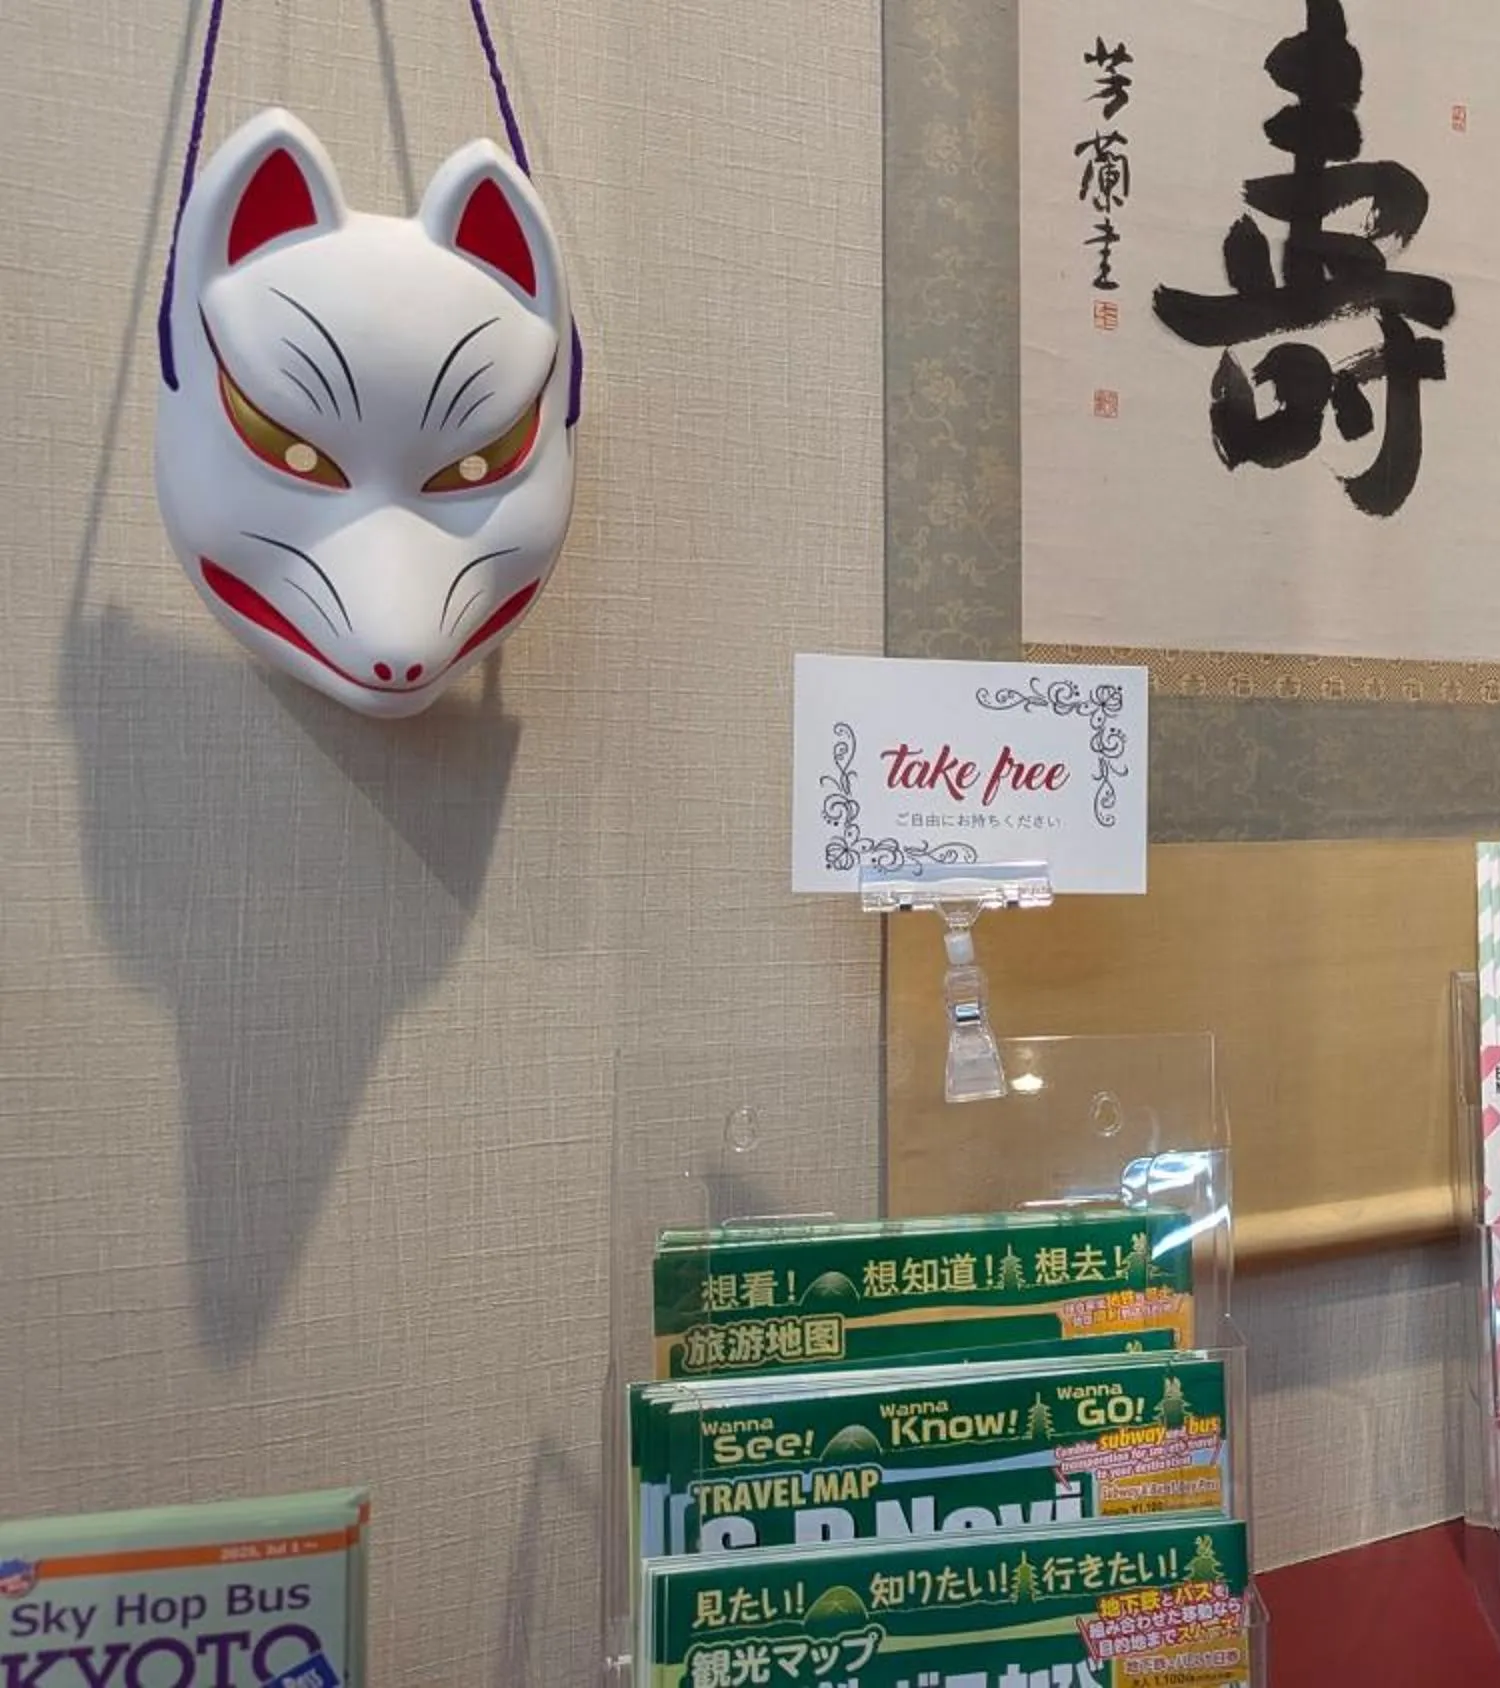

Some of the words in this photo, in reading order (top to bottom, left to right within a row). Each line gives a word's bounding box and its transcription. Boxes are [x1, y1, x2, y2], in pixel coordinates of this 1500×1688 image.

[880, 743, 980, 801] take
[982, 745, 1071, 806] free
[895, 811, 1062, 830] ご自由にお持ちください
[702, 1269, 796, 1312] 想看!
[863, 1253, 994, 1297] 想知道!
[687, 1318, 840, 1366] 旅游地图
[702, 1416, 774, 1436] Wanna
[880, 1400, 949, 1418] Wanna
[891, 1409, 1018, 1446] Know!
[1077, 1396, 1145, 1426] GO!
[714, 1430, 815, 1464] See!
[1101, 1426, 1166, 1450] subway
[1190, 1417, 1218, 1435] bus
[693, 1475, 807, 1515] TRAVEL
[813, 1468, 882, 1504] MAP
[870, 1562, 1008, 1609] 知りたい!
[1042, 1547, 1178, 1593] 行きたい!
[9, 1602, 97, 1639] Sky
[114, 1593, 208, 1629] Hop
[226, 1583, 311, 1617] Bus
[692, 1581, 804, 1629] 見たい!
[0, 1624, 322, 1688] KYOTO
[691, 1631, 878, 1688] 観光マップ
